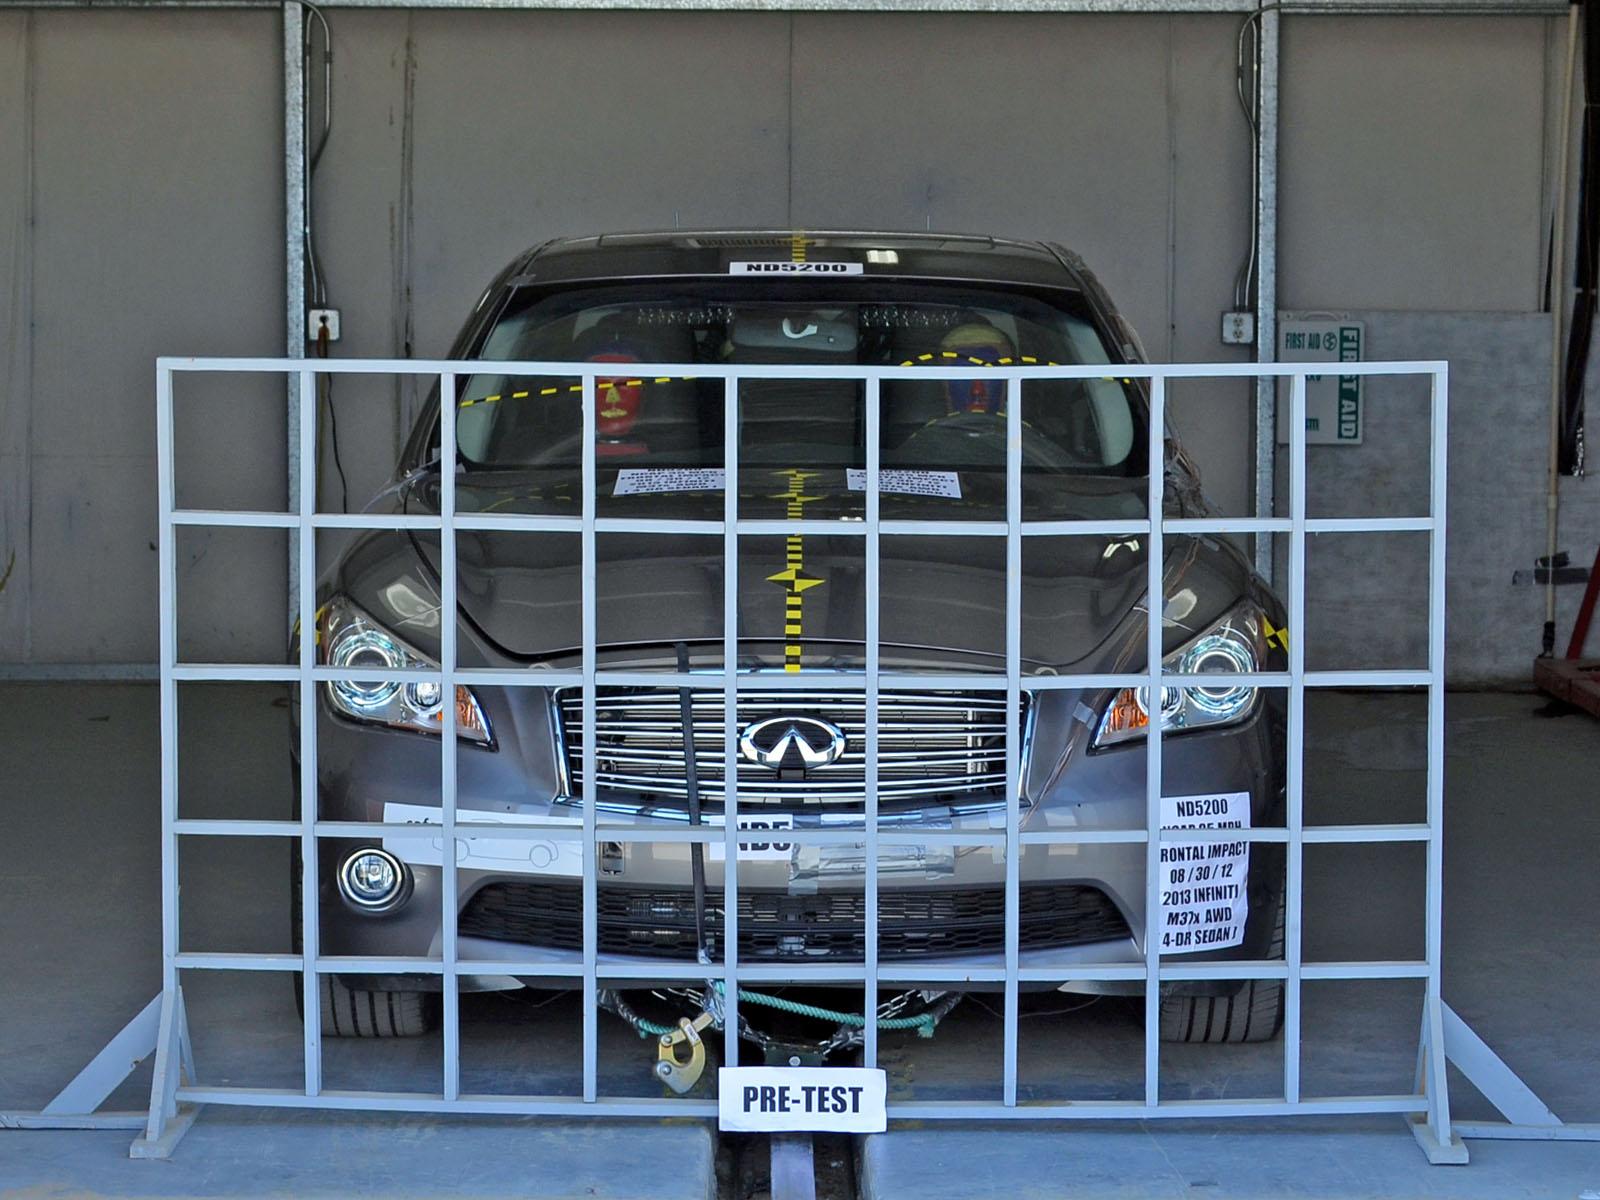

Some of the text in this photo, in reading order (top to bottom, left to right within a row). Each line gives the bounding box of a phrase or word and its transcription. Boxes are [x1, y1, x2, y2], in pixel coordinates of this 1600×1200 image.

[746, 263, 847, 272] ND5200
[1285, 332, 1320, 350] FIRST AID
[1341, 400, 1357, 437] AID
[1176, 799, 1229, 818] ND5200
[1160, 841, 1248, 863] RONTAL IMPACT
[1170, 868, 1186, 884] 08
[1195, 865, 1211, 882] 30
[1221, 863, 1233, 878] 12
[1162, 884, 1239, 906] 2013 INFINITI
[1204, 906, 1232, 924] AWD
[1162, 931, 1192, 947] 4-DR
[1194, 926, 1231, 945] SEDAN
[743, 1086, 864, 1113] PRE-TEST
